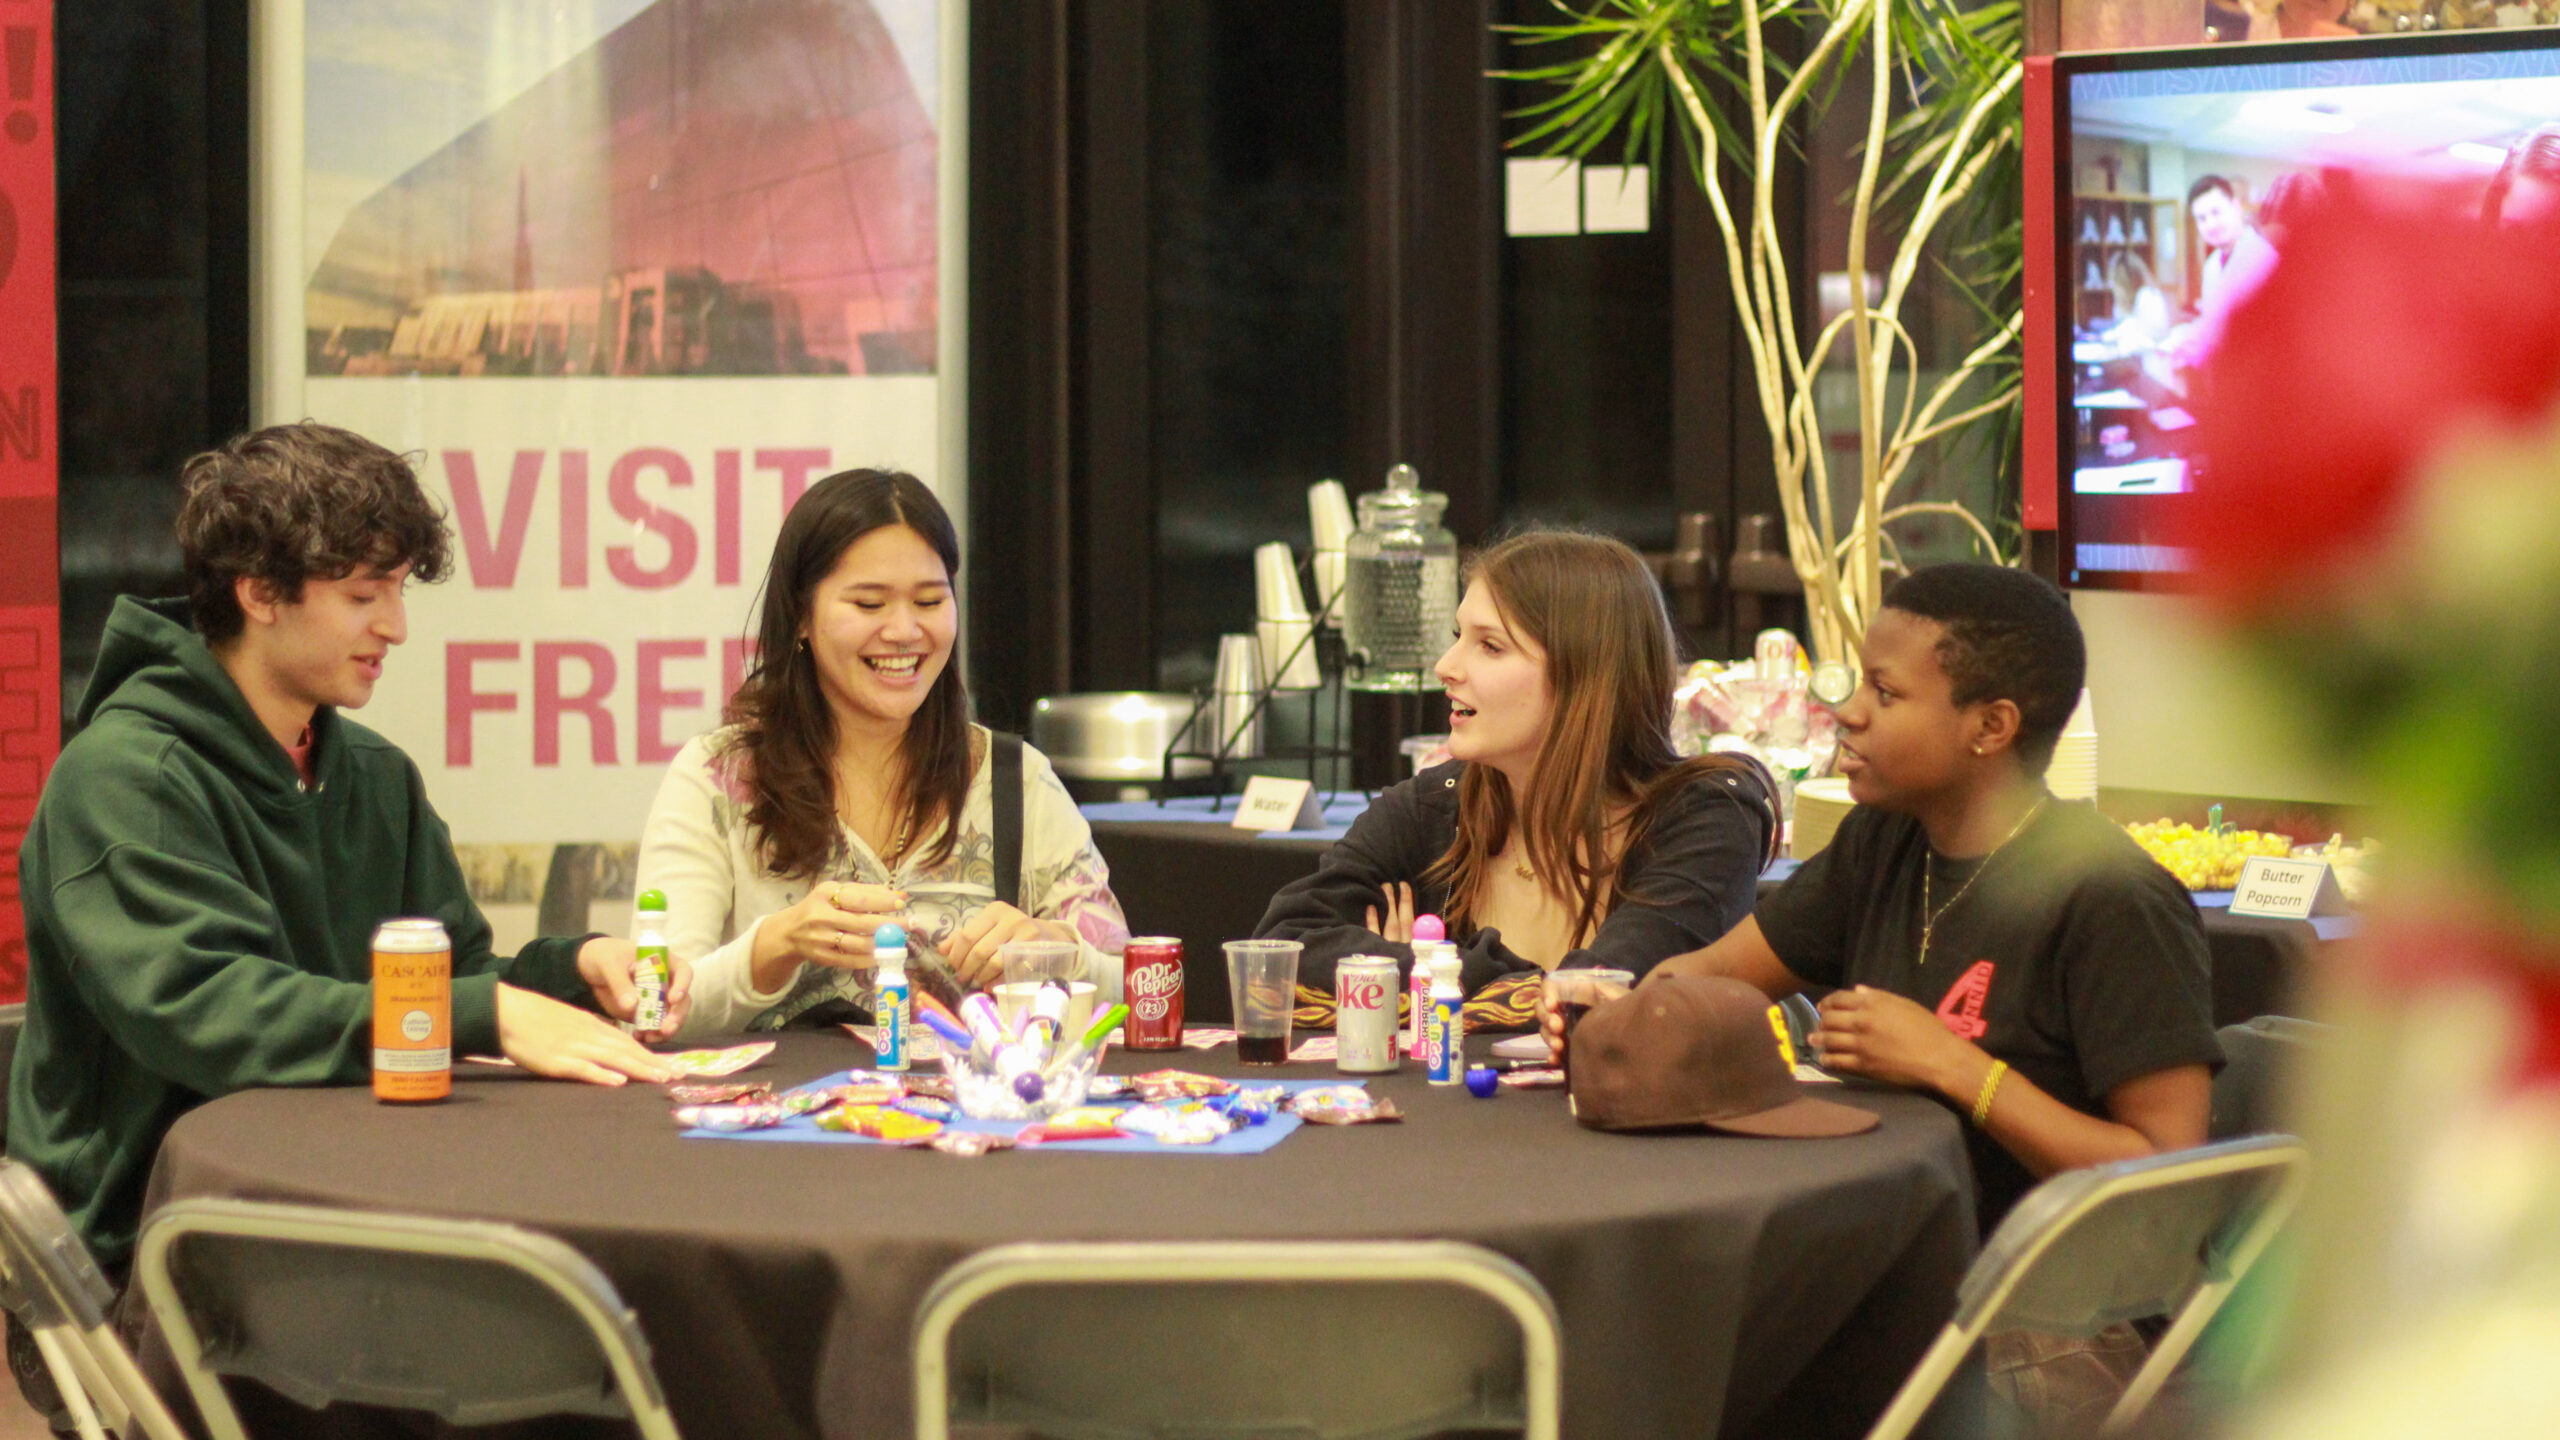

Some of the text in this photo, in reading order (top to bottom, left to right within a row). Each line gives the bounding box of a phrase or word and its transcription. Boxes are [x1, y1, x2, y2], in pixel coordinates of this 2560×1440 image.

[441, 446, 832, 590] VISIT
[1253, 796, 1291, 813] Water
[2260, 868, 2304, 884] Butter
[2246, 890, 2302, 907] Popcorn
[1151, 962, 1172, 981] Dr
[1131, 966, 1181, 997] Pepper
[1145, 1002, 1158, 1015] 23
